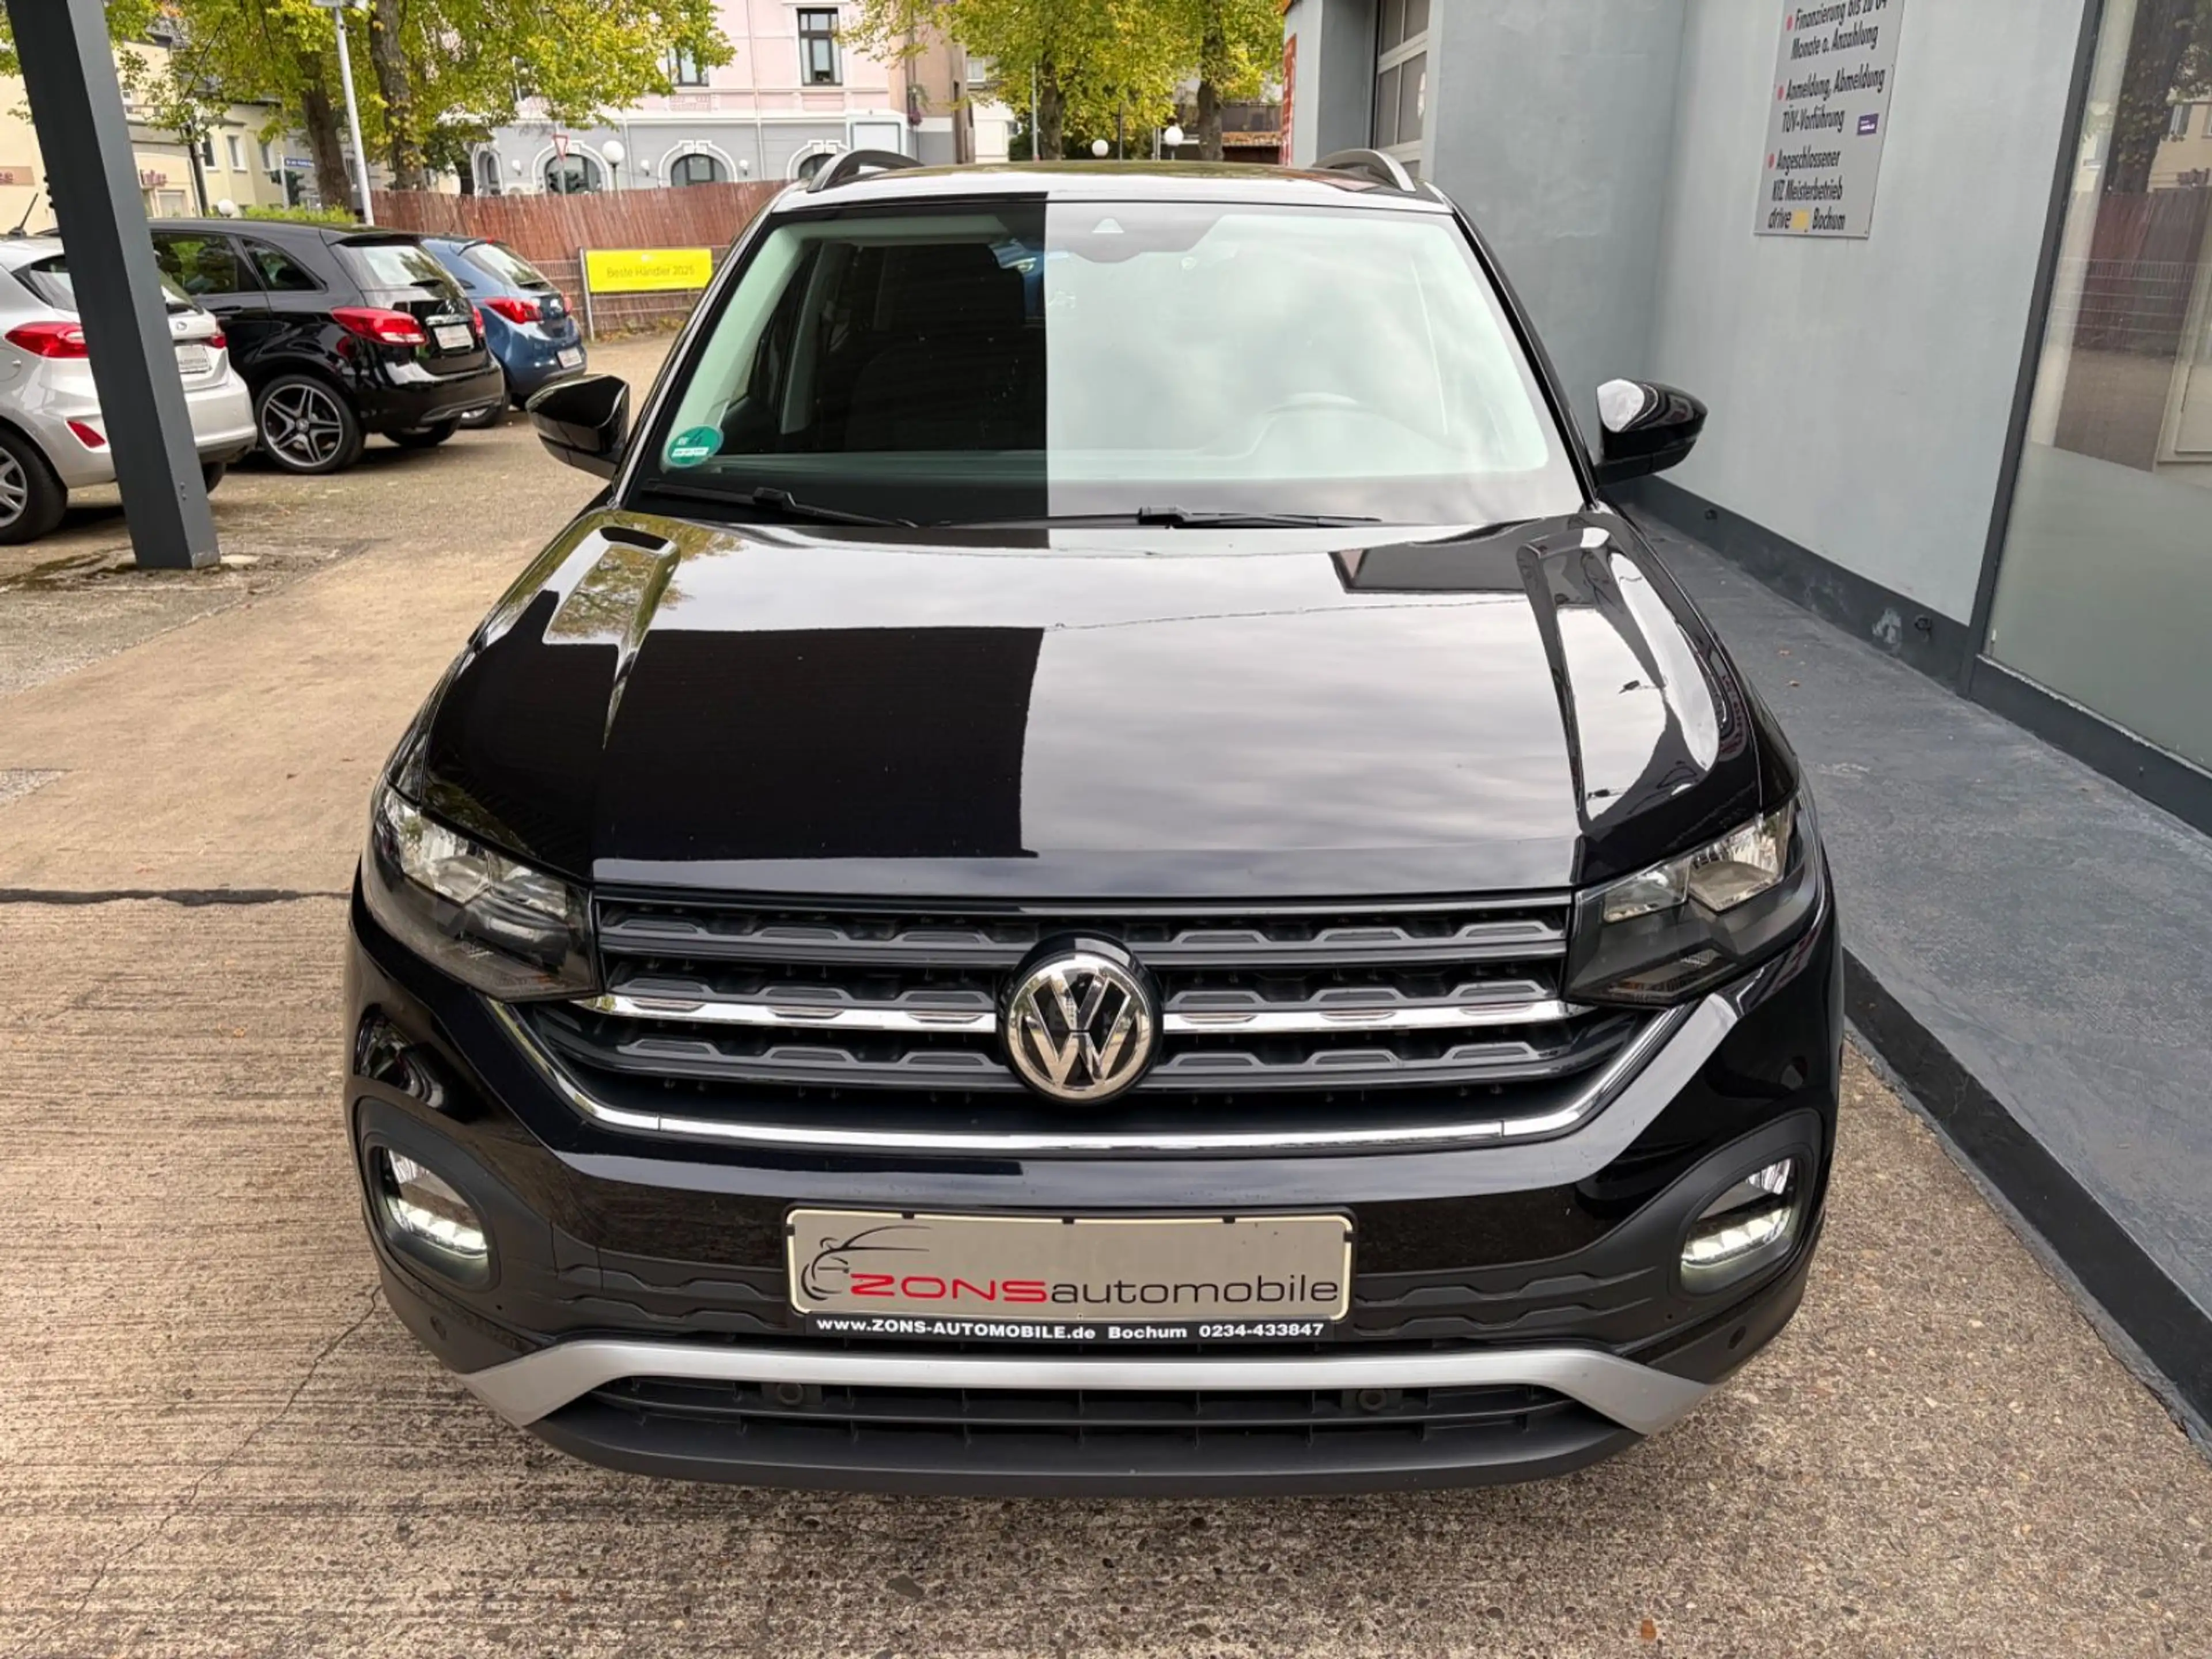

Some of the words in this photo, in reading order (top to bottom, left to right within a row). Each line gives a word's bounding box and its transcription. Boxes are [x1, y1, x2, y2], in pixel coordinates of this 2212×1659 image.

[1794, 3, 1846, 31] Finanzierung
[1848, 0, 1862, 17] bis
[1791, 36, 1821, 60] Monate
[1831, 21, 1878, 51] Anzahlung
[1786, 72, 1831, 101] Anmeldung,
[1832, 63, 1885, 93] Abmeldung
[1782, 104, 1845, 133] TÜV-Vorführung
[1777, 144, 1841, 176] Angeschlossener
[1785, 175, 1843, 200] Meisterbetrieb
[1768, 207, 1791, 229] drive
[1812, 205, 1846, 230] Bochum
[607, 267, 632, 278] Beste
[635, 265, 670, 277] Händler
[850, 1273, 1339, 1304] ZONSautomobile
[816, 1319, 1096, 1340] www.ZONS-AUTOMOBILE.de
[1107, 1325, 1187, 1339] Bochum
[1198, 1323, 1324, 1338] 0234-433847
